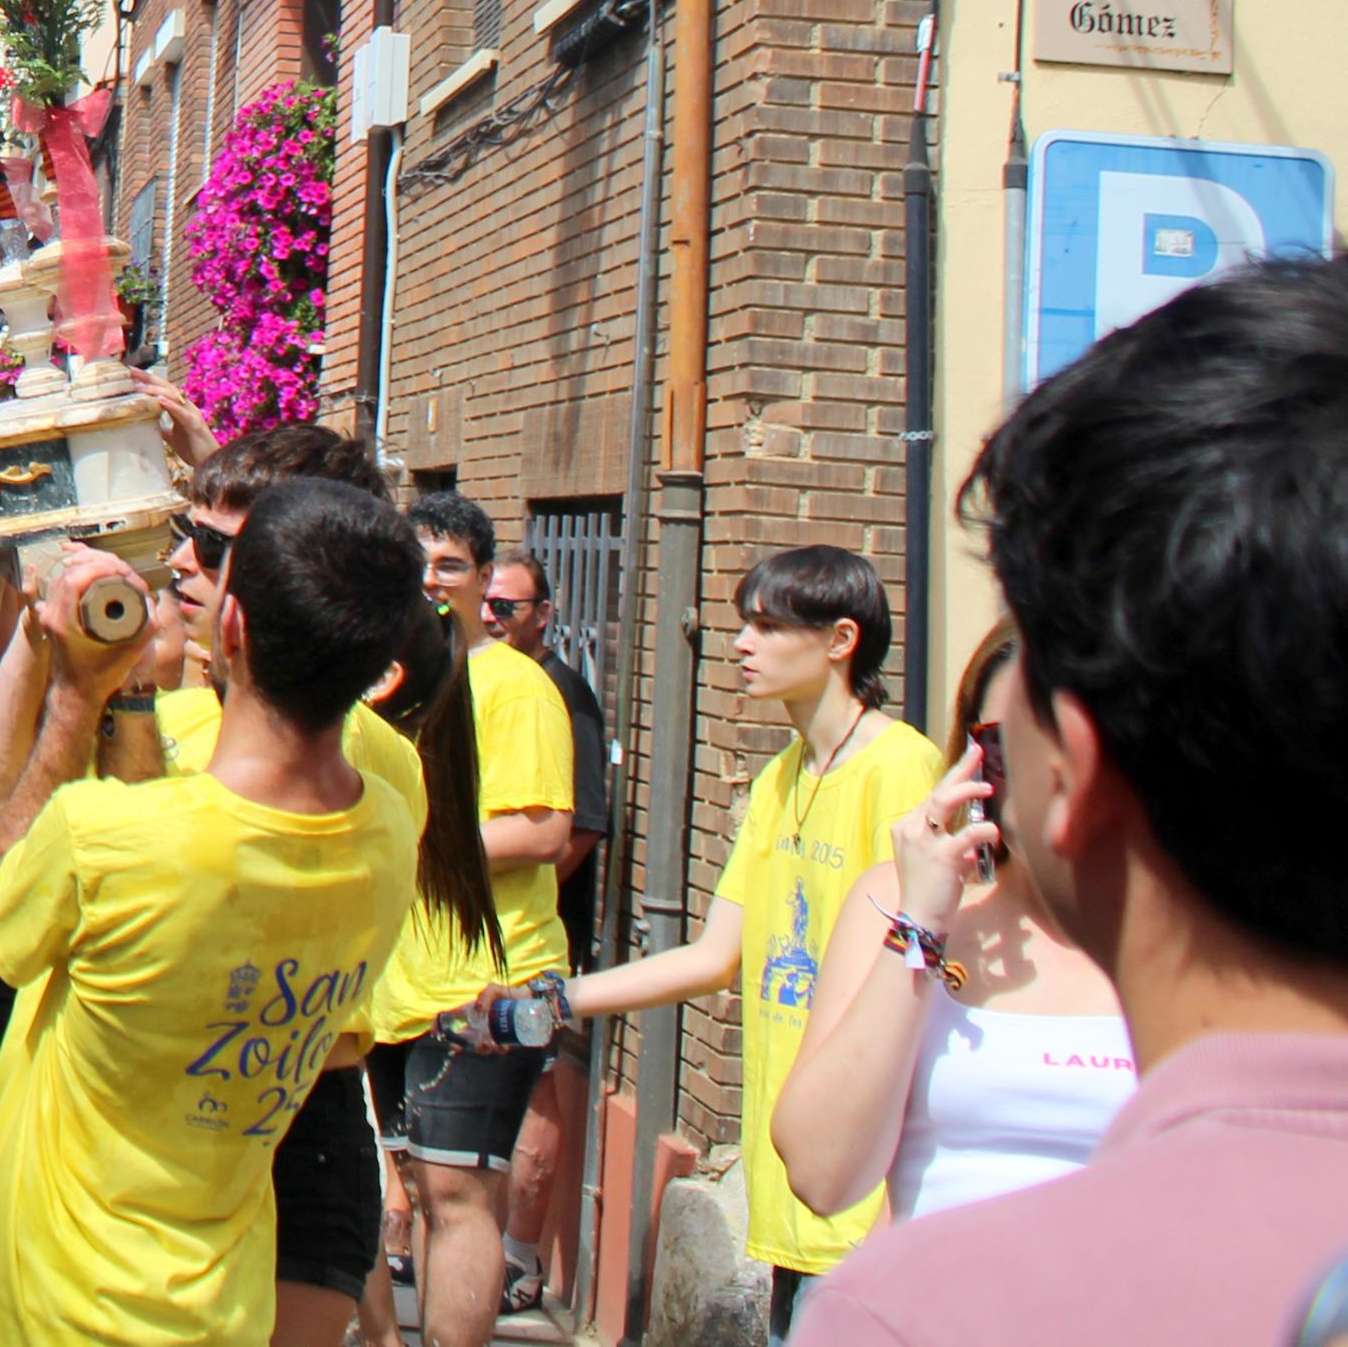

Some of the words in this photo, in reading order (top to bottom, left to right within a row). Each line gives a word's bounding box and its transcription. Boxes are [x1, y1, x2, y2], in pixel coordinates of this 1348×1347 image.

[1069, 1, 1178, 40] Gómez
[1095, 170, 1268, 343] P
[260, 958, 368, 1027] San
[185, 1015, 334, 1084] Zoilo
